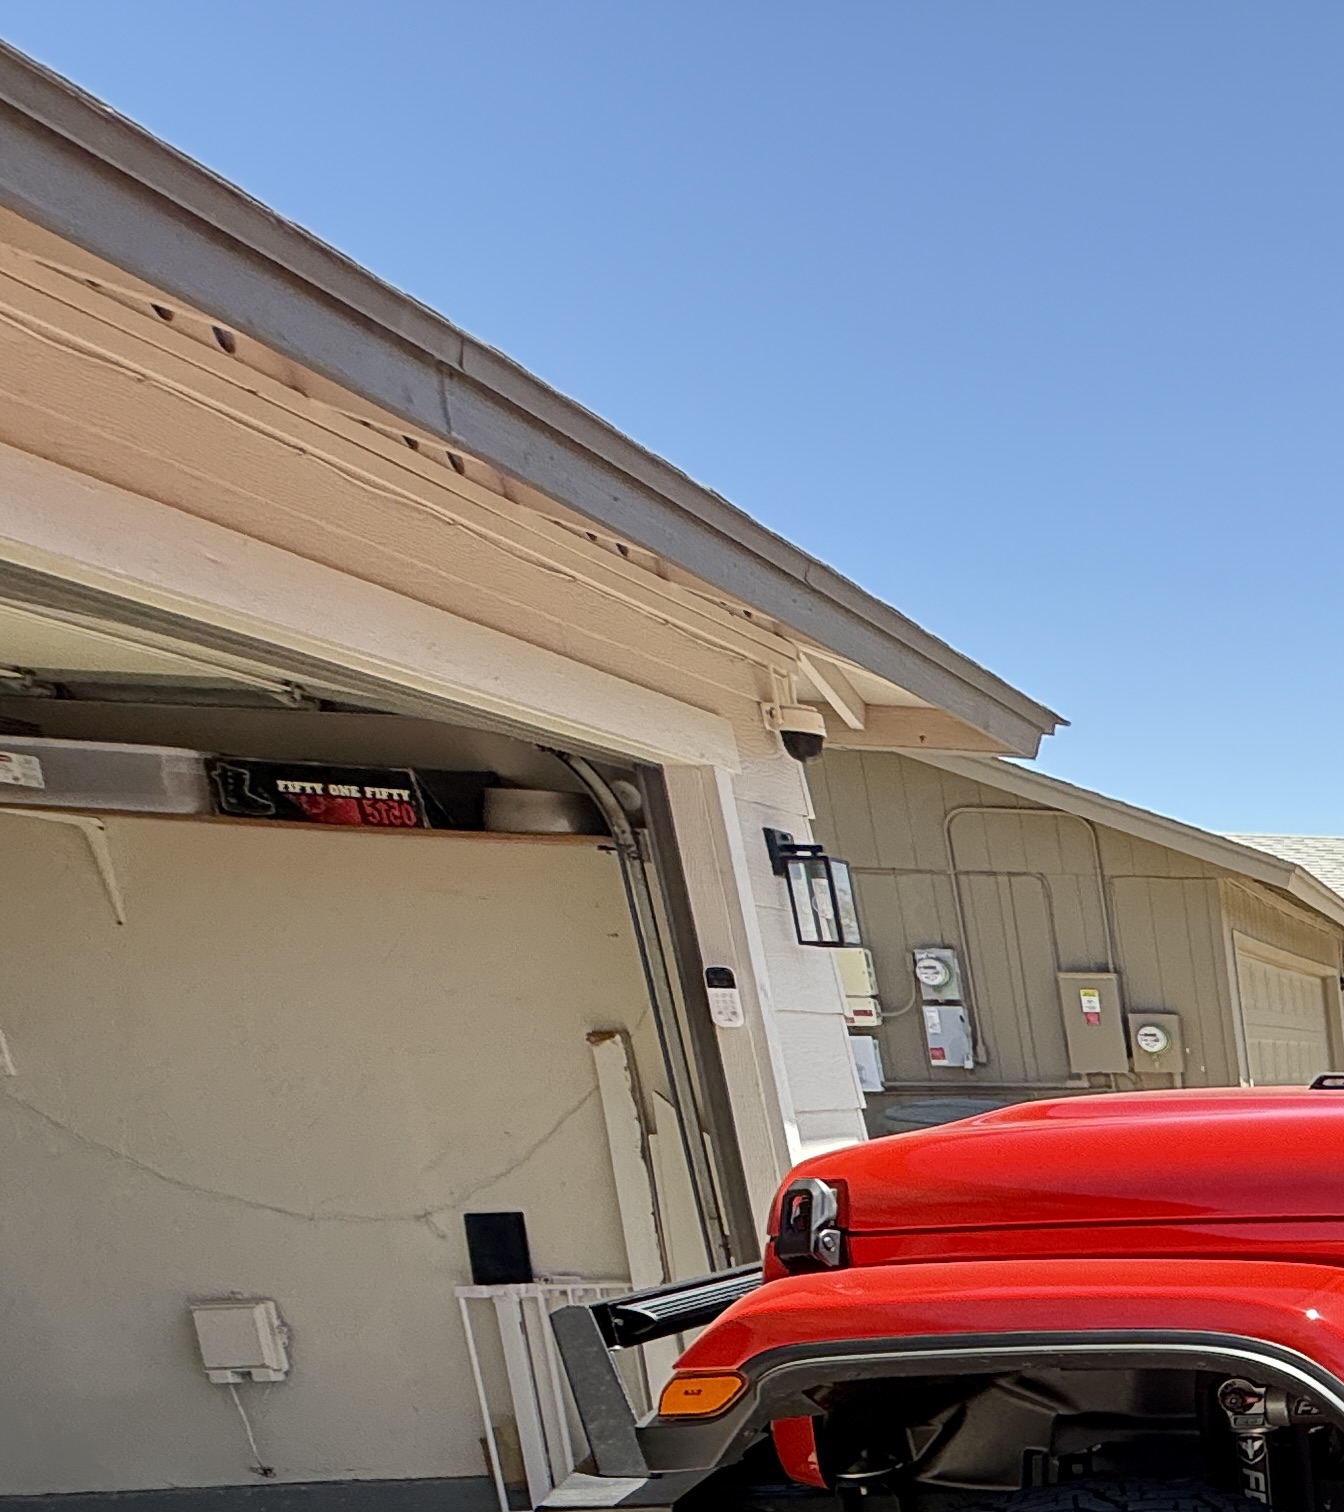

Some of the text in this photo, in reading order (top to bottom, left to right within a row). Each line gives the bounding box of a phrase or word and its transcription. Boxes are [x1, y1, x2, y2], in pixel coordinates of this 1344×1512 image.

[276, 780, 410, 801] FIFTY ONE FIFTY
[362, 800, 416, 826] 5150
